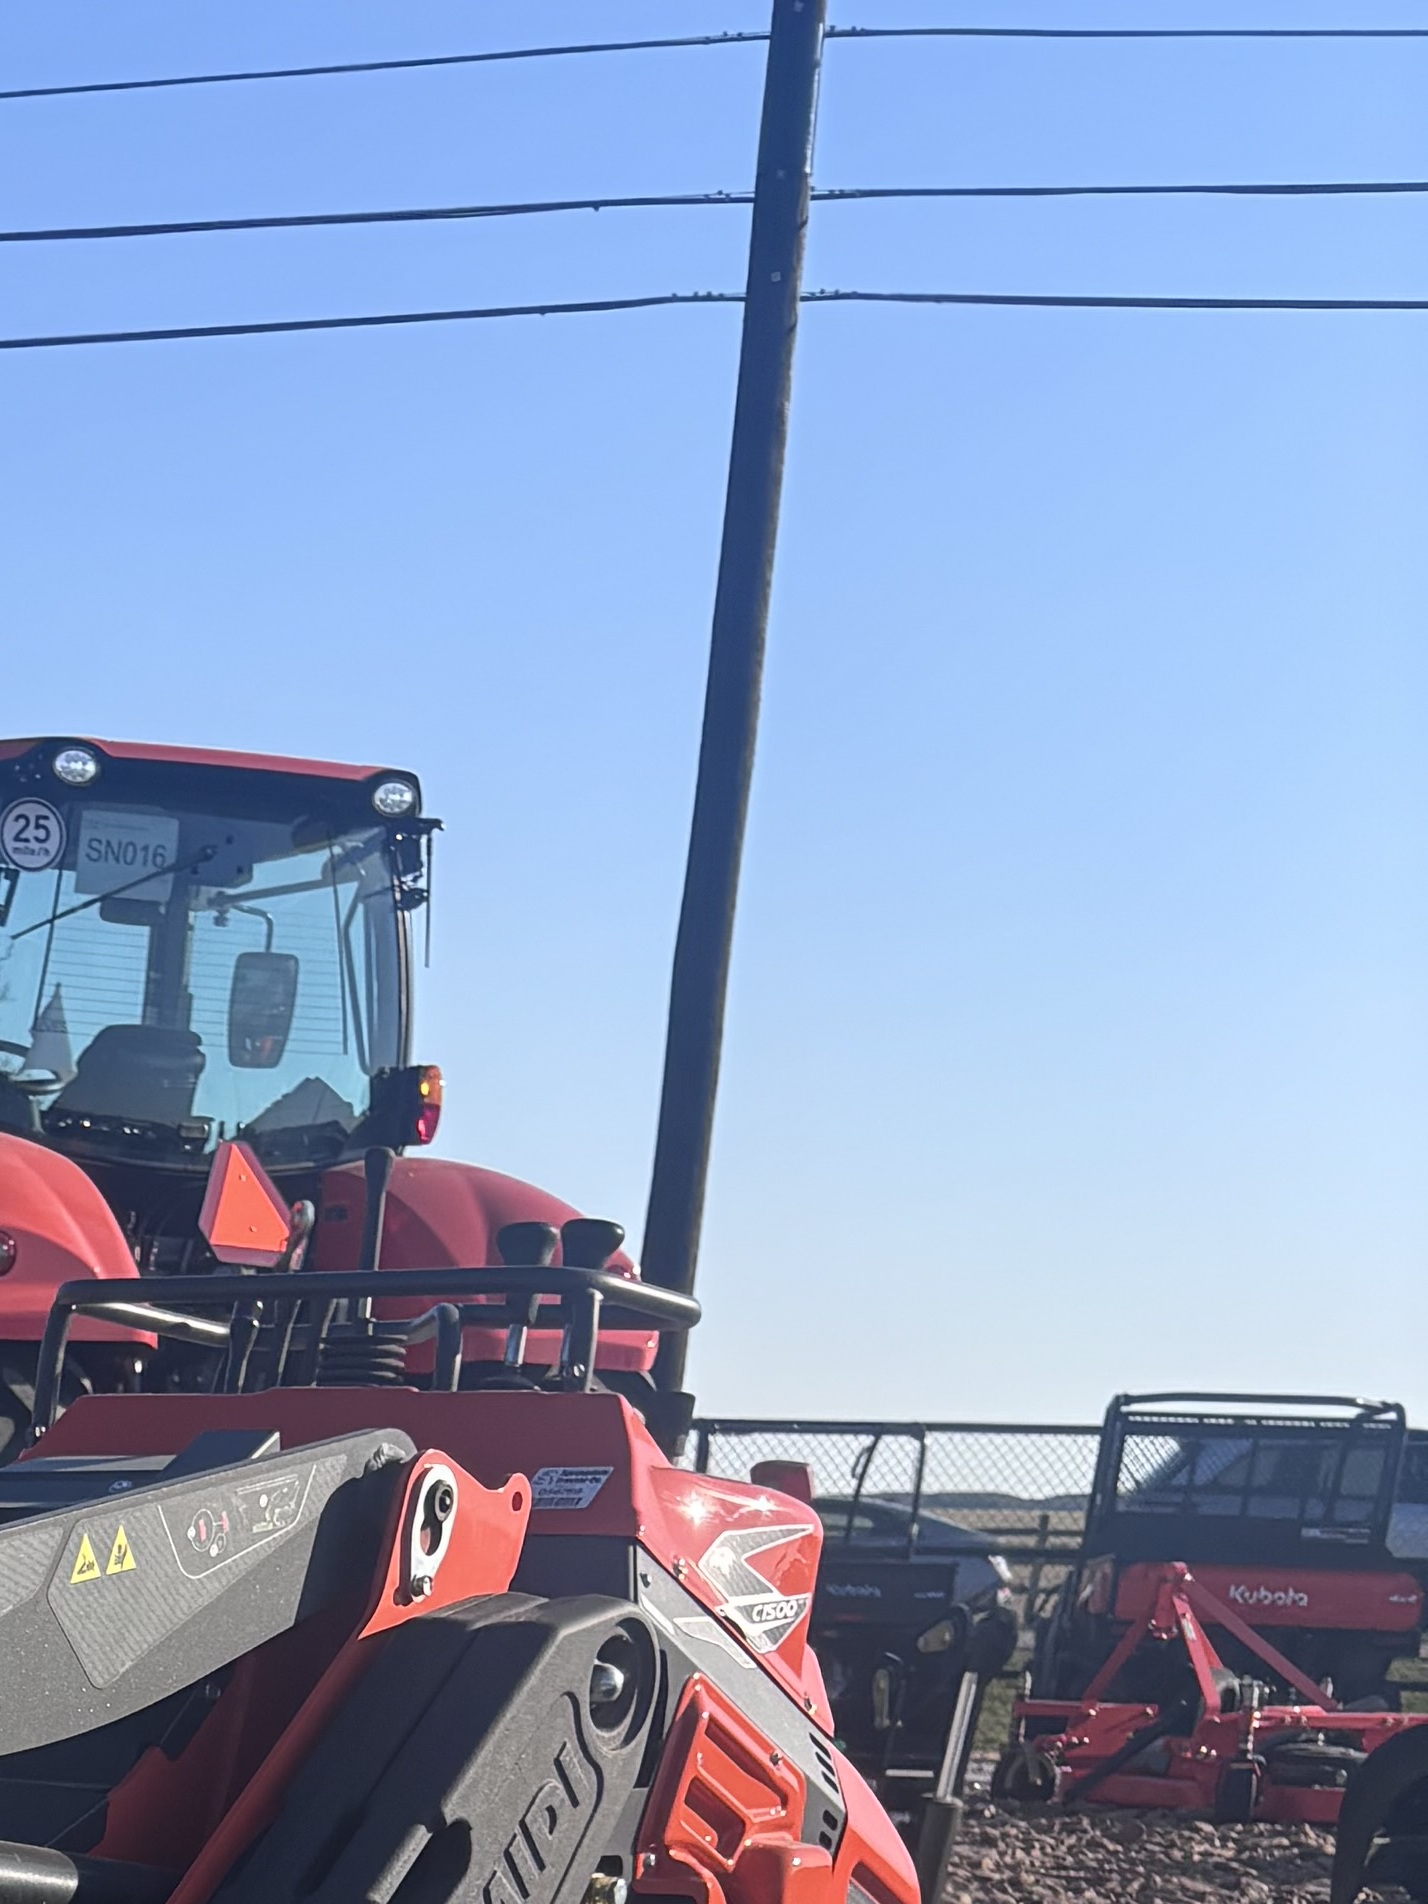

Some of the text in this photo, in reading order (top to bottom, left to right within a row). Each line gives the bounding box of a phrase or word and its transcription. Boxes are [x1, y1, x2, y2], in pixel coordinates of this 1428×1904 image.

[12, 813, 51, 844] 25
[85, 838, 167, 867] SN016
[1229, 1584, 1309, 1607] Kubota
[751, 1600, 798, 1622] C1500
